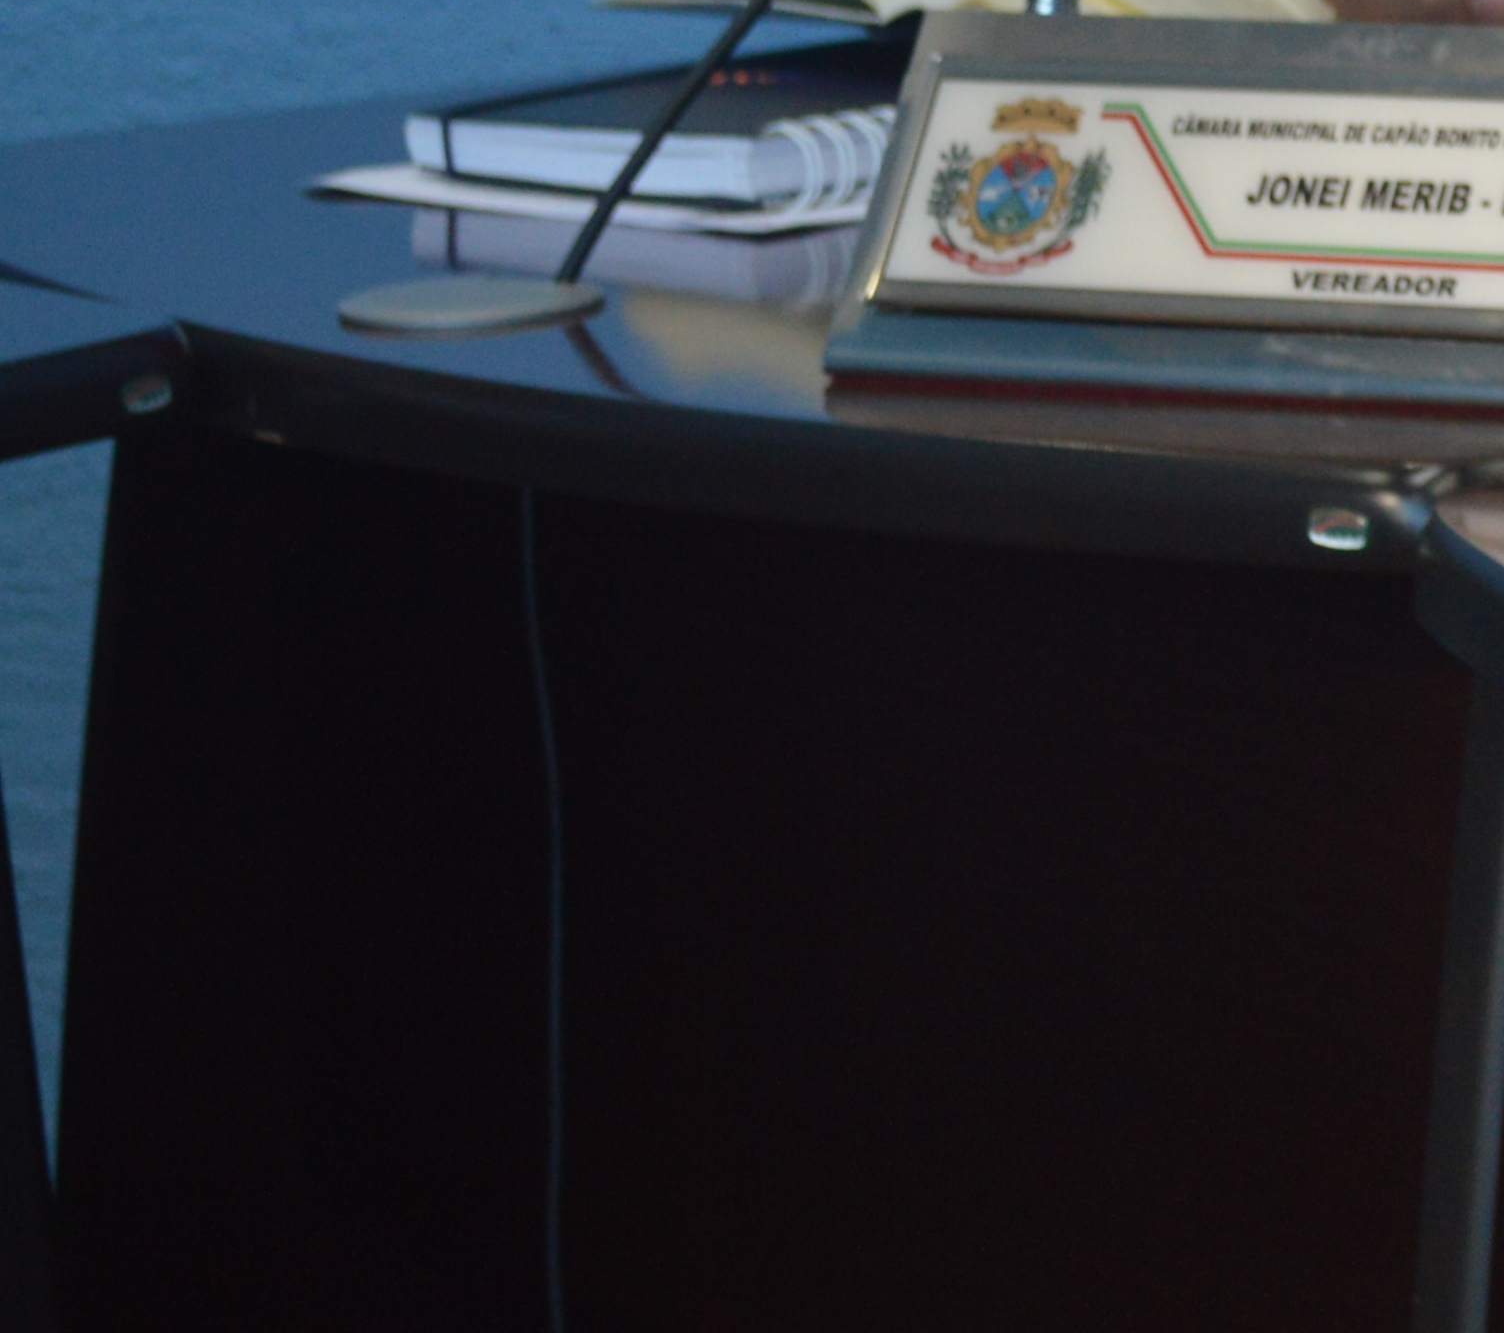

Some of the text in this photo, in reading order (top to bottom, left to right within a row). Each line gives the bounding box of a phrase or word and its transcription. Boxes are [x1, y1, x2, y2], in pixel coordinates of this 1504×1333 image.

[1248, 119, 1337, 142] MUNICIPAL
[1344, 122, 1365, 143] DE
[1435, 126, 1500, 149] BONITO
[1246, 174, 1351, 209] JONEI
[1360, 178, 1471, 213] MERIB
[1290, 269, 1458, 298] VEREADOR
